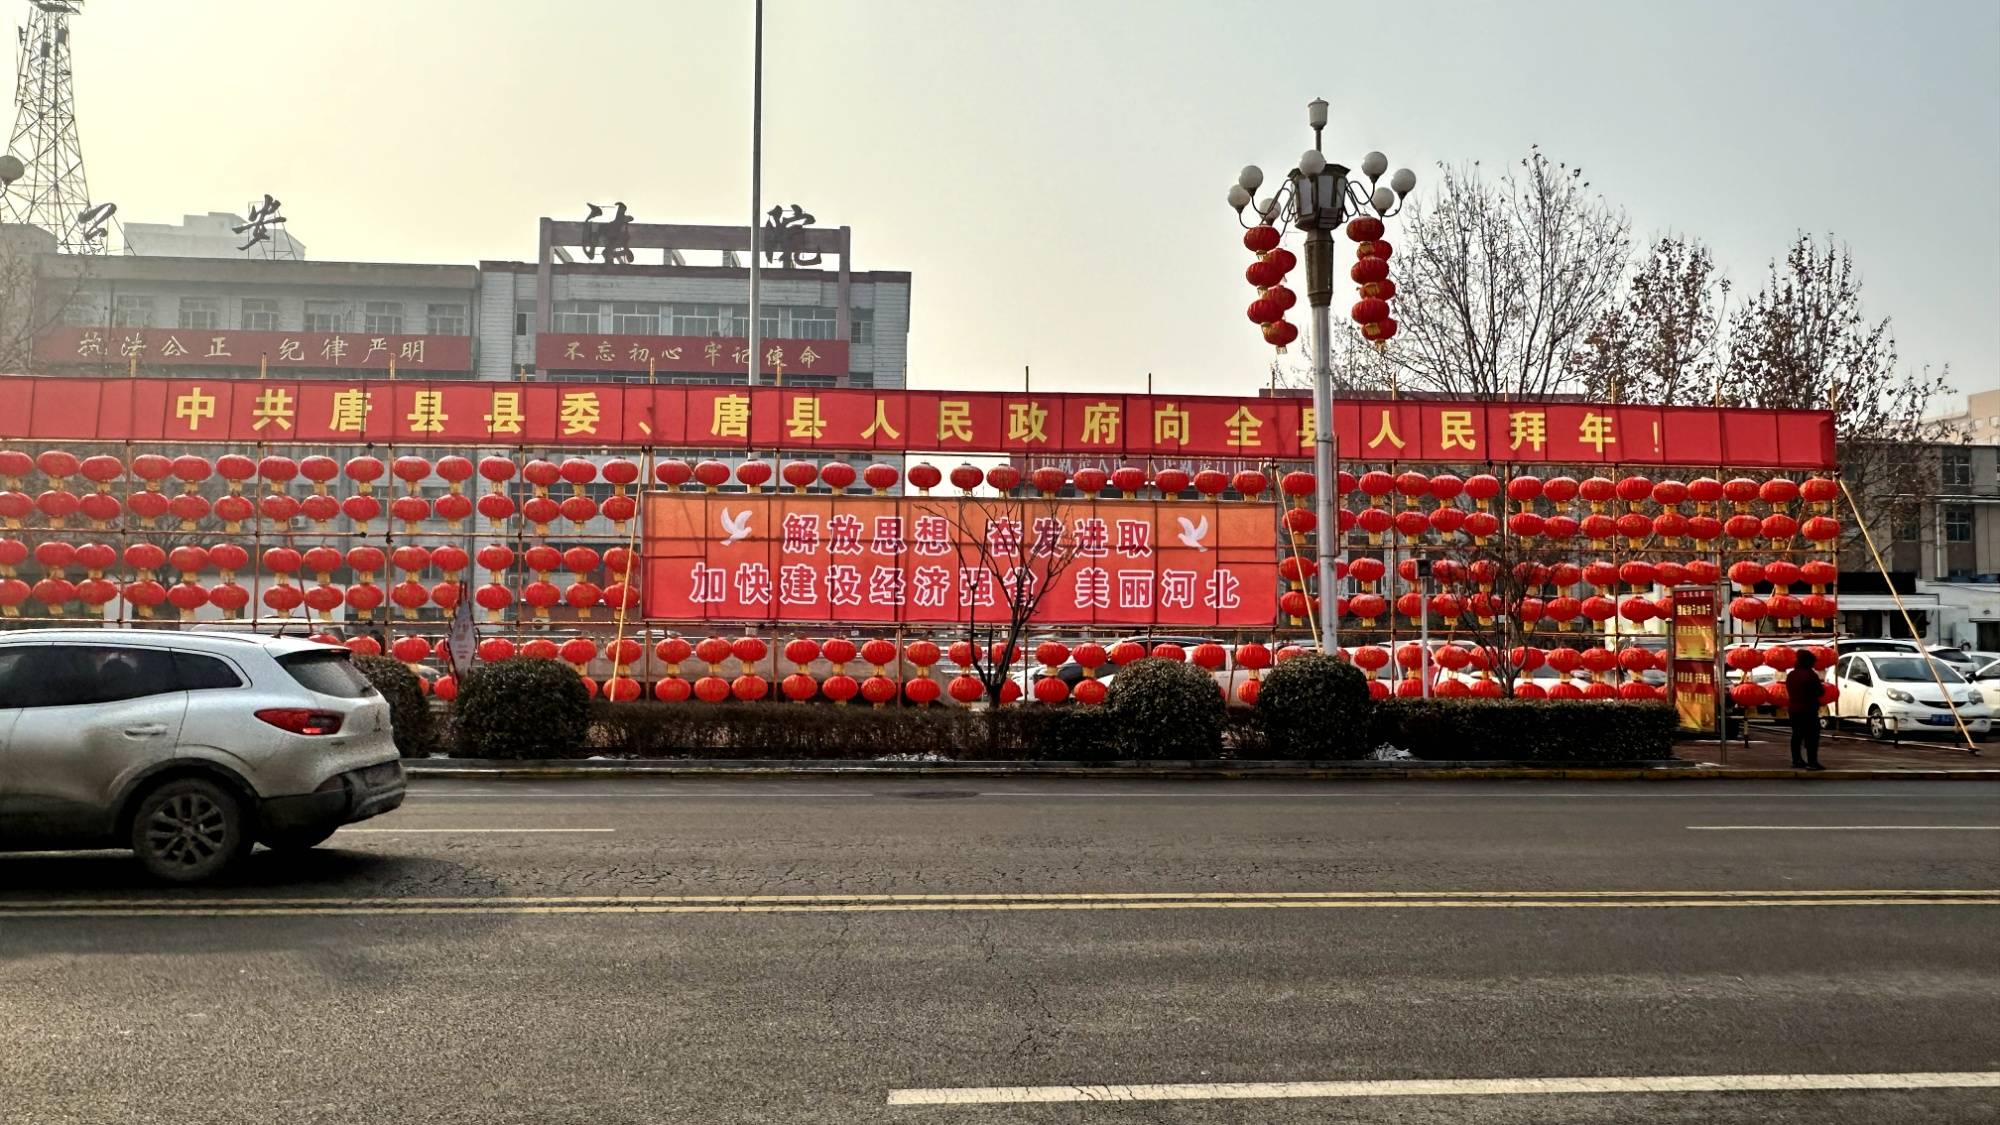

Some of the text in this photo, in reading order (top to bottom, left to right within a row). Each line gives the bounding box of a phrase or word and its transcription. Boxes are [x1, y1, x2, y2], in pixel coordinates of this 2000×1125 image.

[78, 331, 425, 366] 执法公正 纪律严明
[564, 341, 821, 369] 不忘初心 牢记使命
[782, 513, 1153, 559] 解放思想 奋发进取
[689, 561, 1241, 609] 加快建设经济强省 美丽河北
